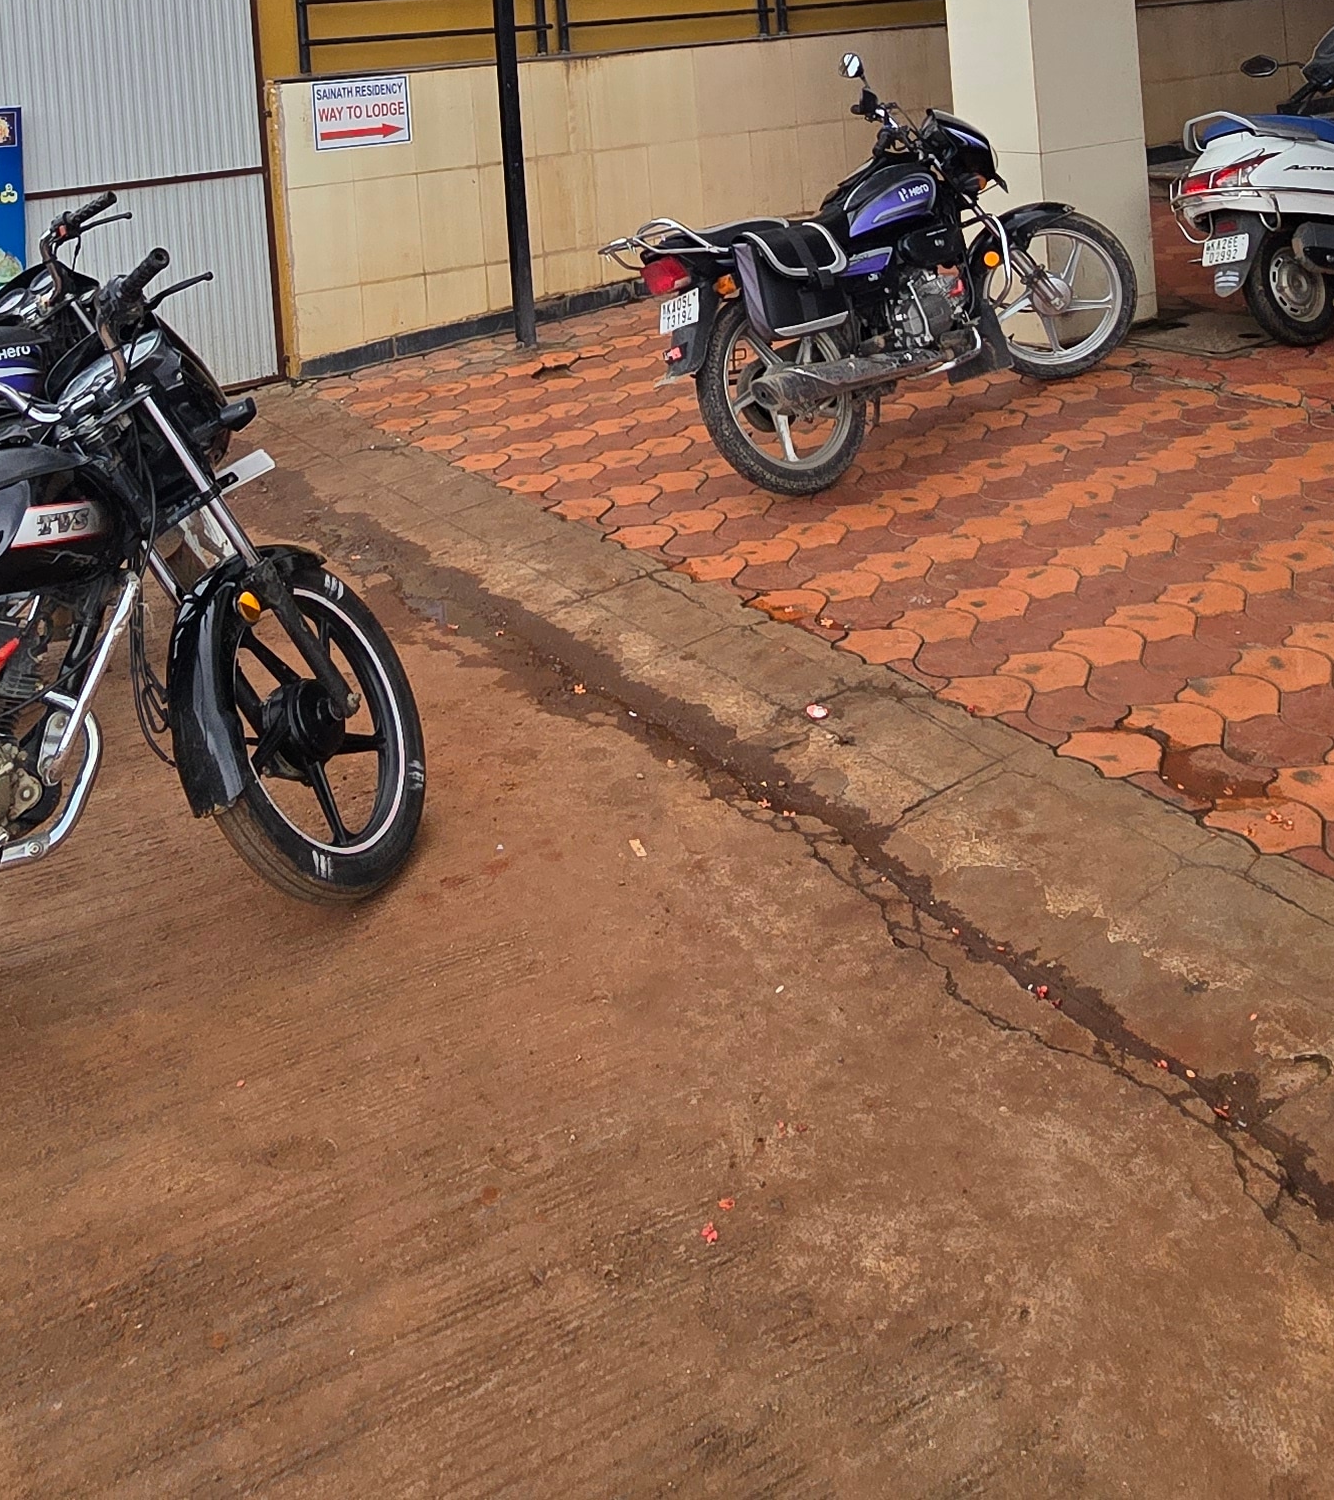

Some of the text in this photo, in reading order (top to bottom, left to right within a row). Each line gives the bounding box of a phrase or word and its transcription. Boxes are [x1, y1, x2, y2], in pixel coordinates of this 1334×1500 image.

[316, 82, 403, 100] SAINATH RESIDENCY
[318, 101, 405, 122] WAY TO LODGE
[36, 508, 90, 536] TVS
